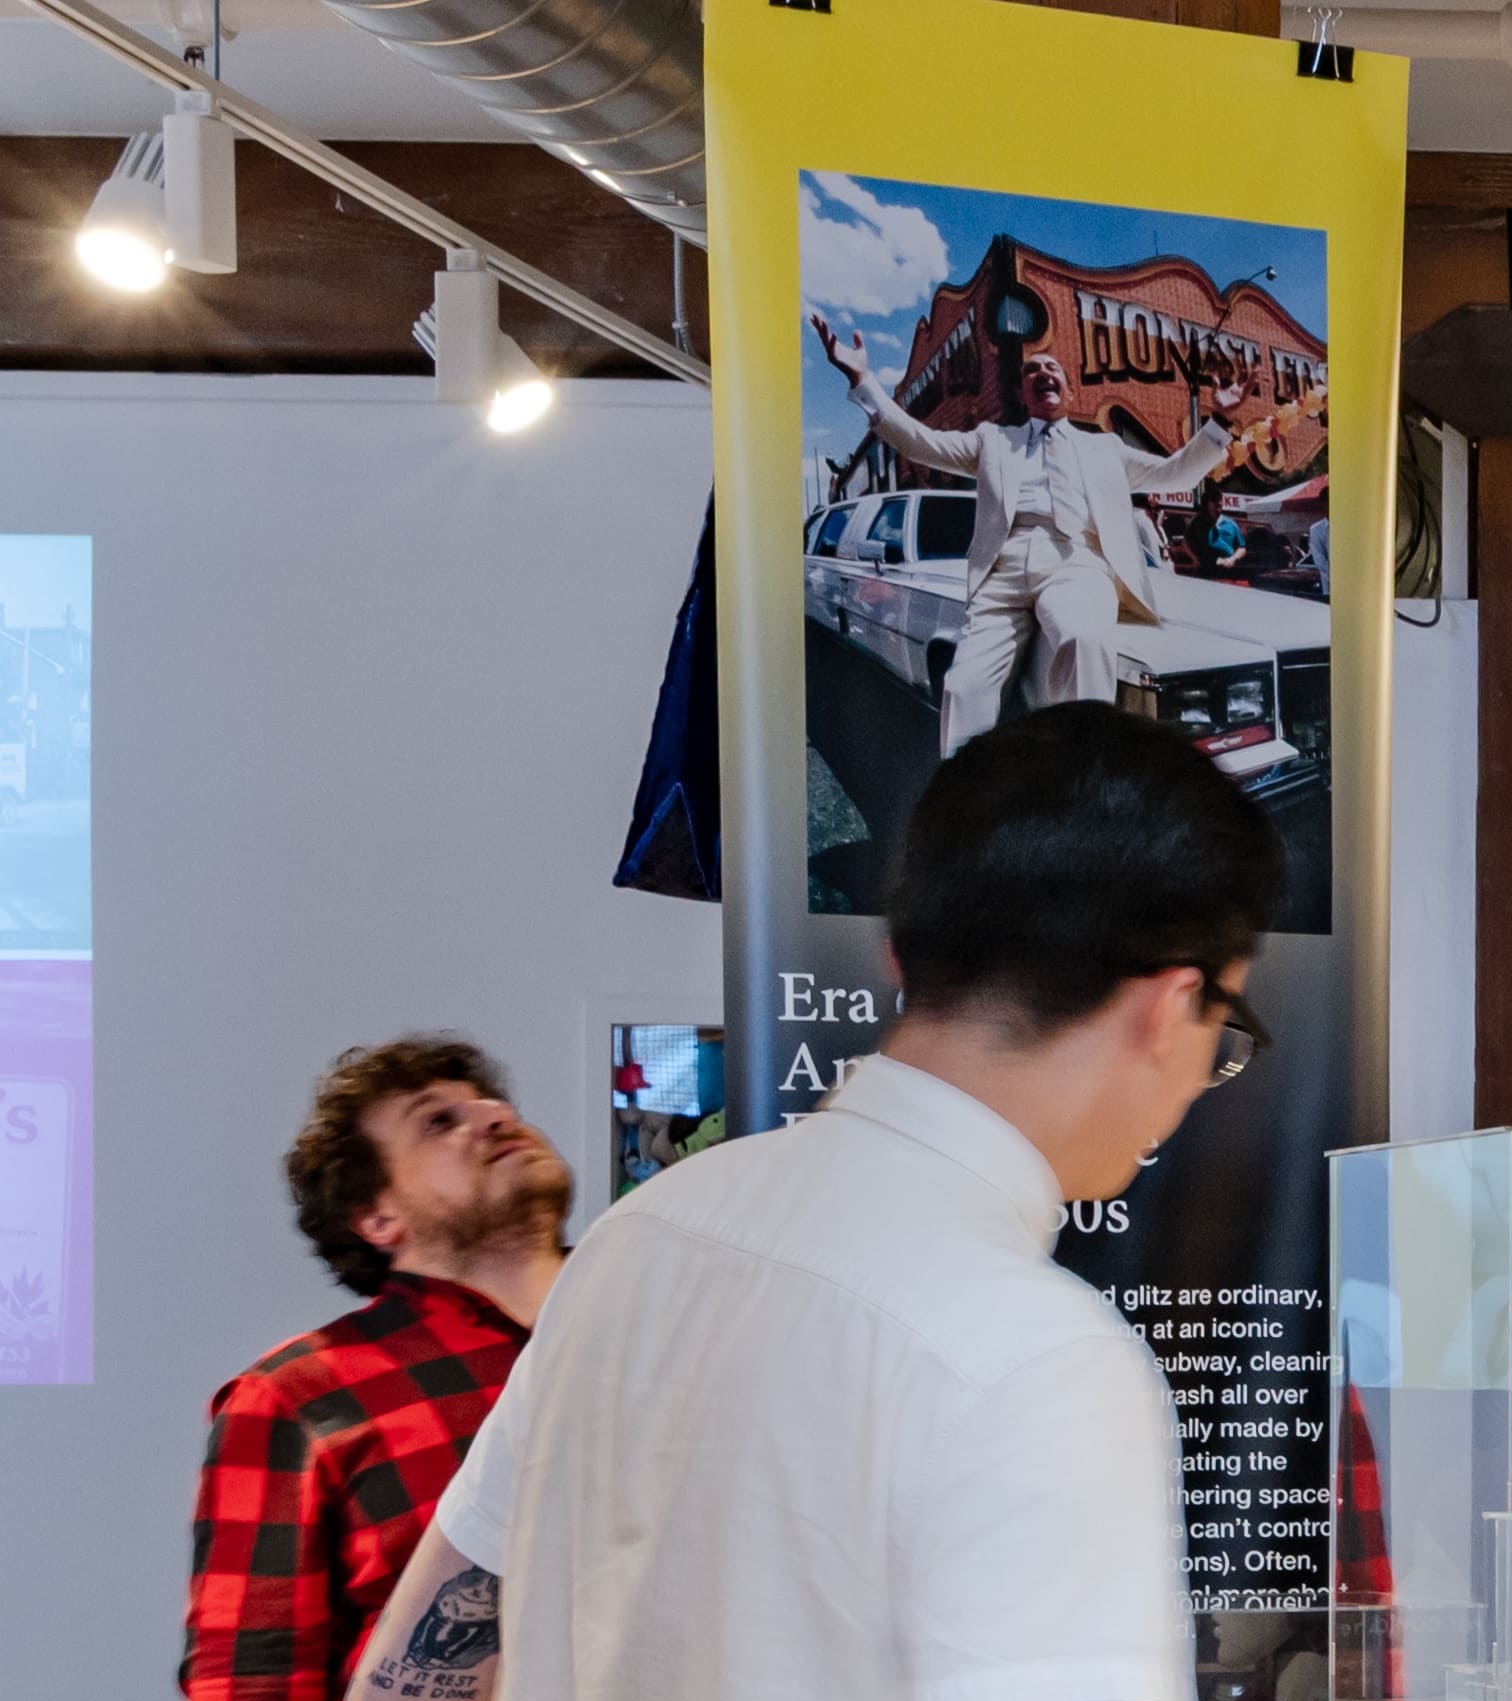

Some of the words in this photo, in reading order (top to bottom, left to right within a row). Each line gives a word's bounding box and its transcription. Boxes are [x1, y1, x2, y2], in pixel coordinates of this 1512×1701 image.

[1076, 289, 1262, 386] HONEST
[778, 973, 878, 1023] Era
[1124, 1285, 1172, 1310] glitz
[1178, 1289, 1211, 1305] are
[1218, 1284, 1322, 1309] ordinary,
[1153, 1320, 1173, 1339] at
[1179, 1323, 1204, 1338] an
[1212, 1317, 1283, 1338] iconic
[1153, 1350, 1242, 1377] subway,
[1250, 1348, 1342, 1379] cleaning
